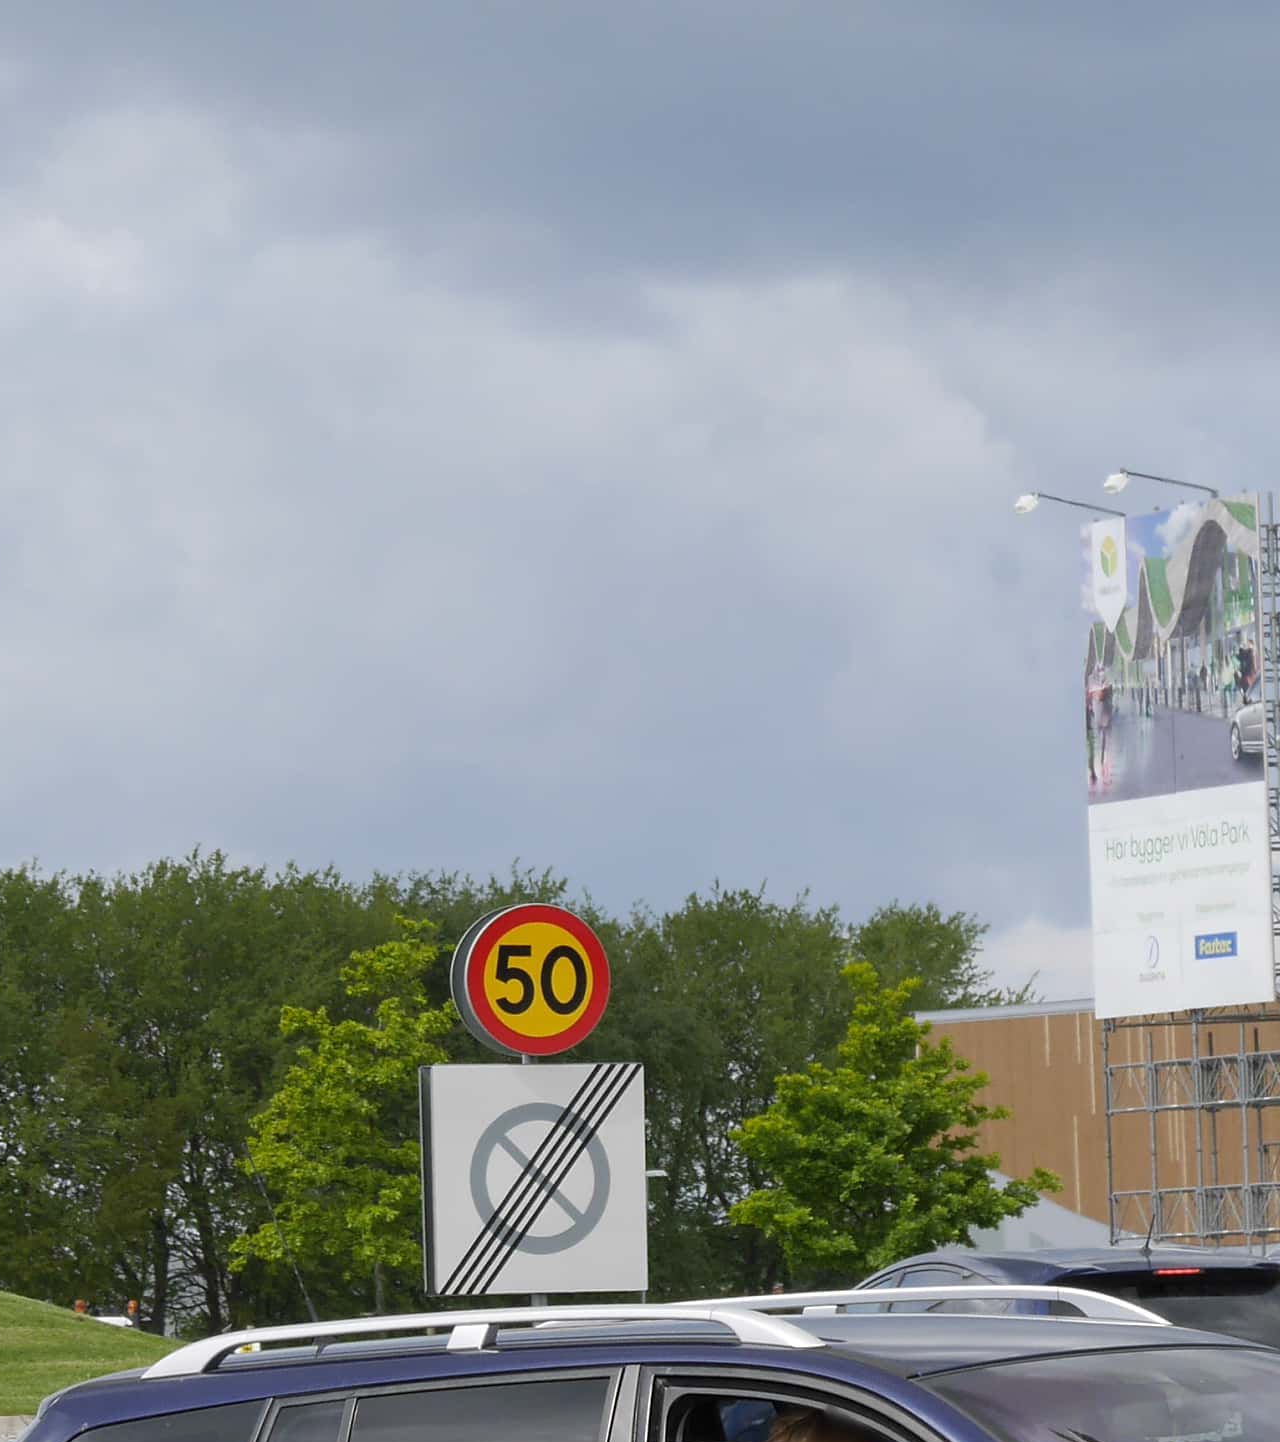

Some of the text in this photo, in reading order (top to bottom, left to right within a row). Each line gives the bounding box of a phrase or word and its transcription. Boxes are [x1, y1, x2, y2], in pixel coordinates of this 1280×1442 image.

[1129, 832, 1174, 864] bygger
[1220, 821, 1250, 844] Park
[495, 945, 587, 1014] 50
